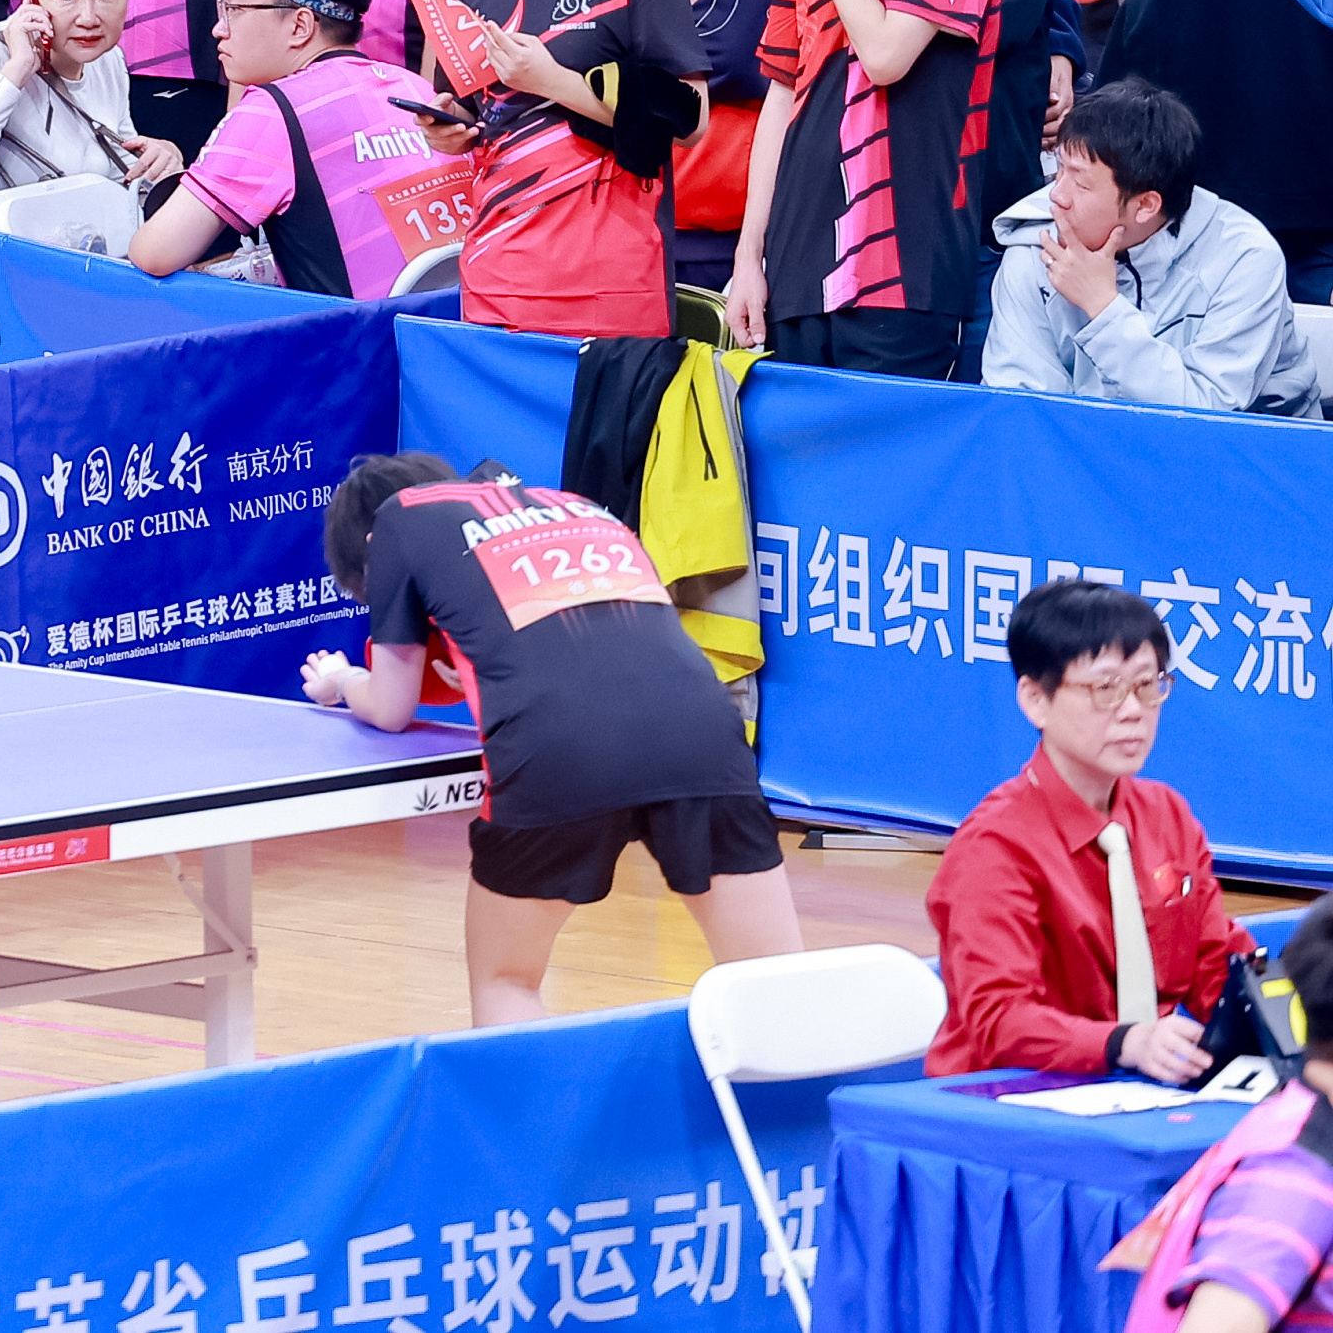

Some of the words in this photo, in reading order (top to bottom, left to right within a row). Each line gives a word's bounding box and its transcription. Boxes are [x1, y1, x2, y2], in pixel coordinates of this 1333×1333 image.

[353, 126, 432, 163] Amity
[226, 439, 314, 483] 南京分行
[46, 524, 106, 556] BANK
[109, 518, 135, 544] OF
[140, 506, 211, 538] CHINA
[229, 489, 309, 523] NANJING
[510, 543, 643, 587] 1262
[88, 655, 105, 668] Cup
[105, 644, 159, 663] International
[159, 639, 181, 654] Table
[181, 634, 210, 649] Tennis
[209, 623, 264, 644] Philanthropic
[263, 616, 310, 634] Tournament
[309, 608, 355, 628] Community
